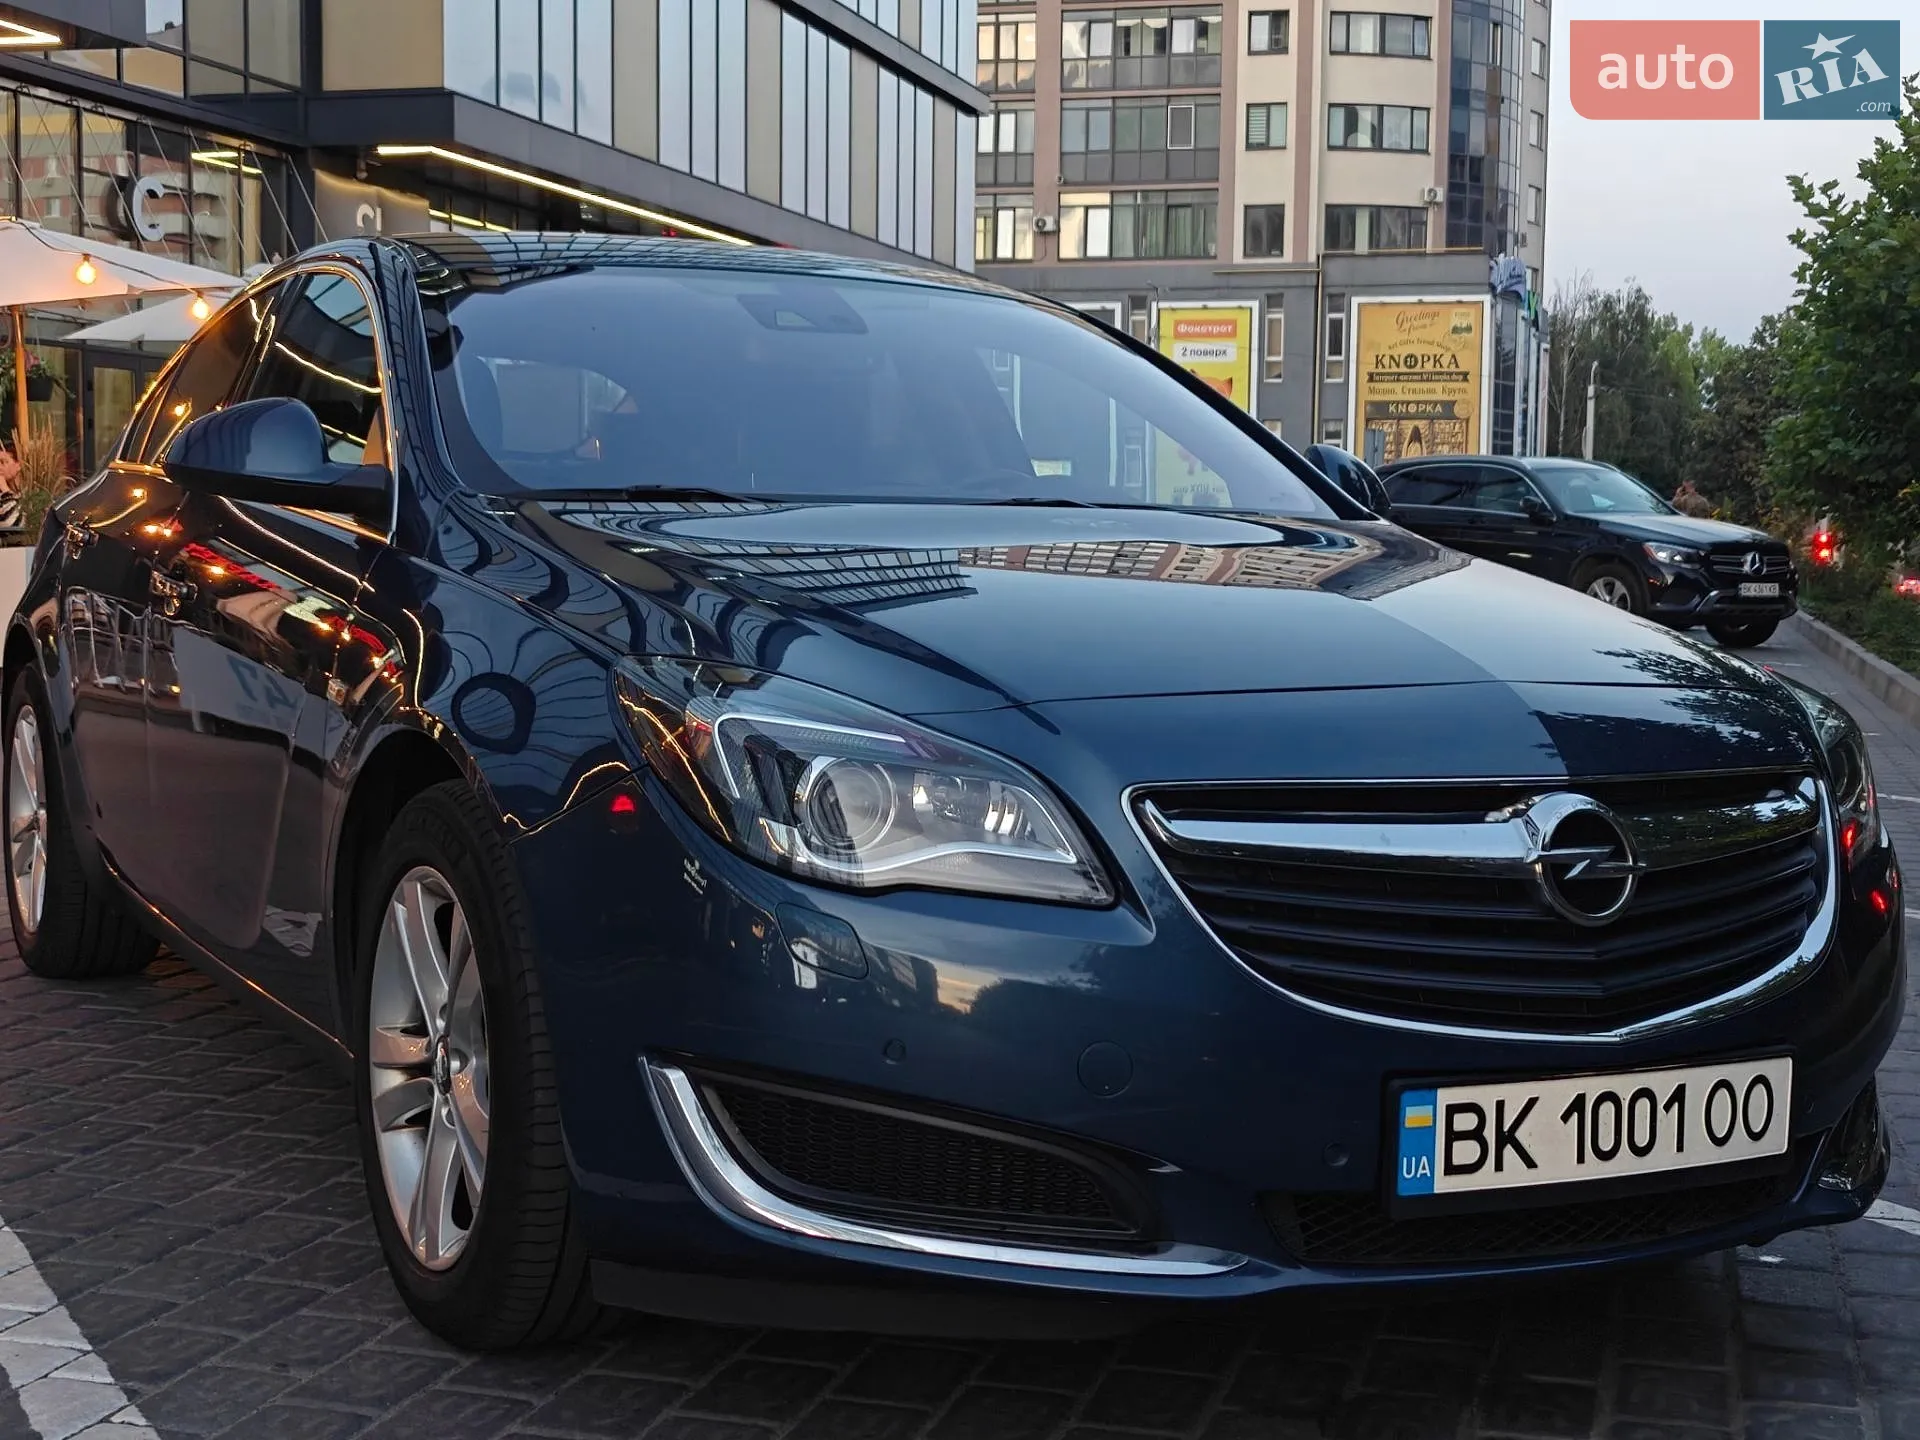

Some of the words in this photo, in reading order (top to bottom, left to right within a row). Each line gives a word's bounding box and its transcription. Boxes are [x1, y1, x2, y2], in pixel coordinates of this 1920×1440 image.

[1180, 346, 1188, 356] 2
[1189, 348, 1228, 358] поверх
[1374, 353, 1460, 369] KNOPKA
[1388, 403, 1443, 414] KNOPKA
[1443, 1096, 1540, 1177] BK
[1560, 1083, 1686, 1165] 1001
[1402, 1155, 1431, 1179] UA
